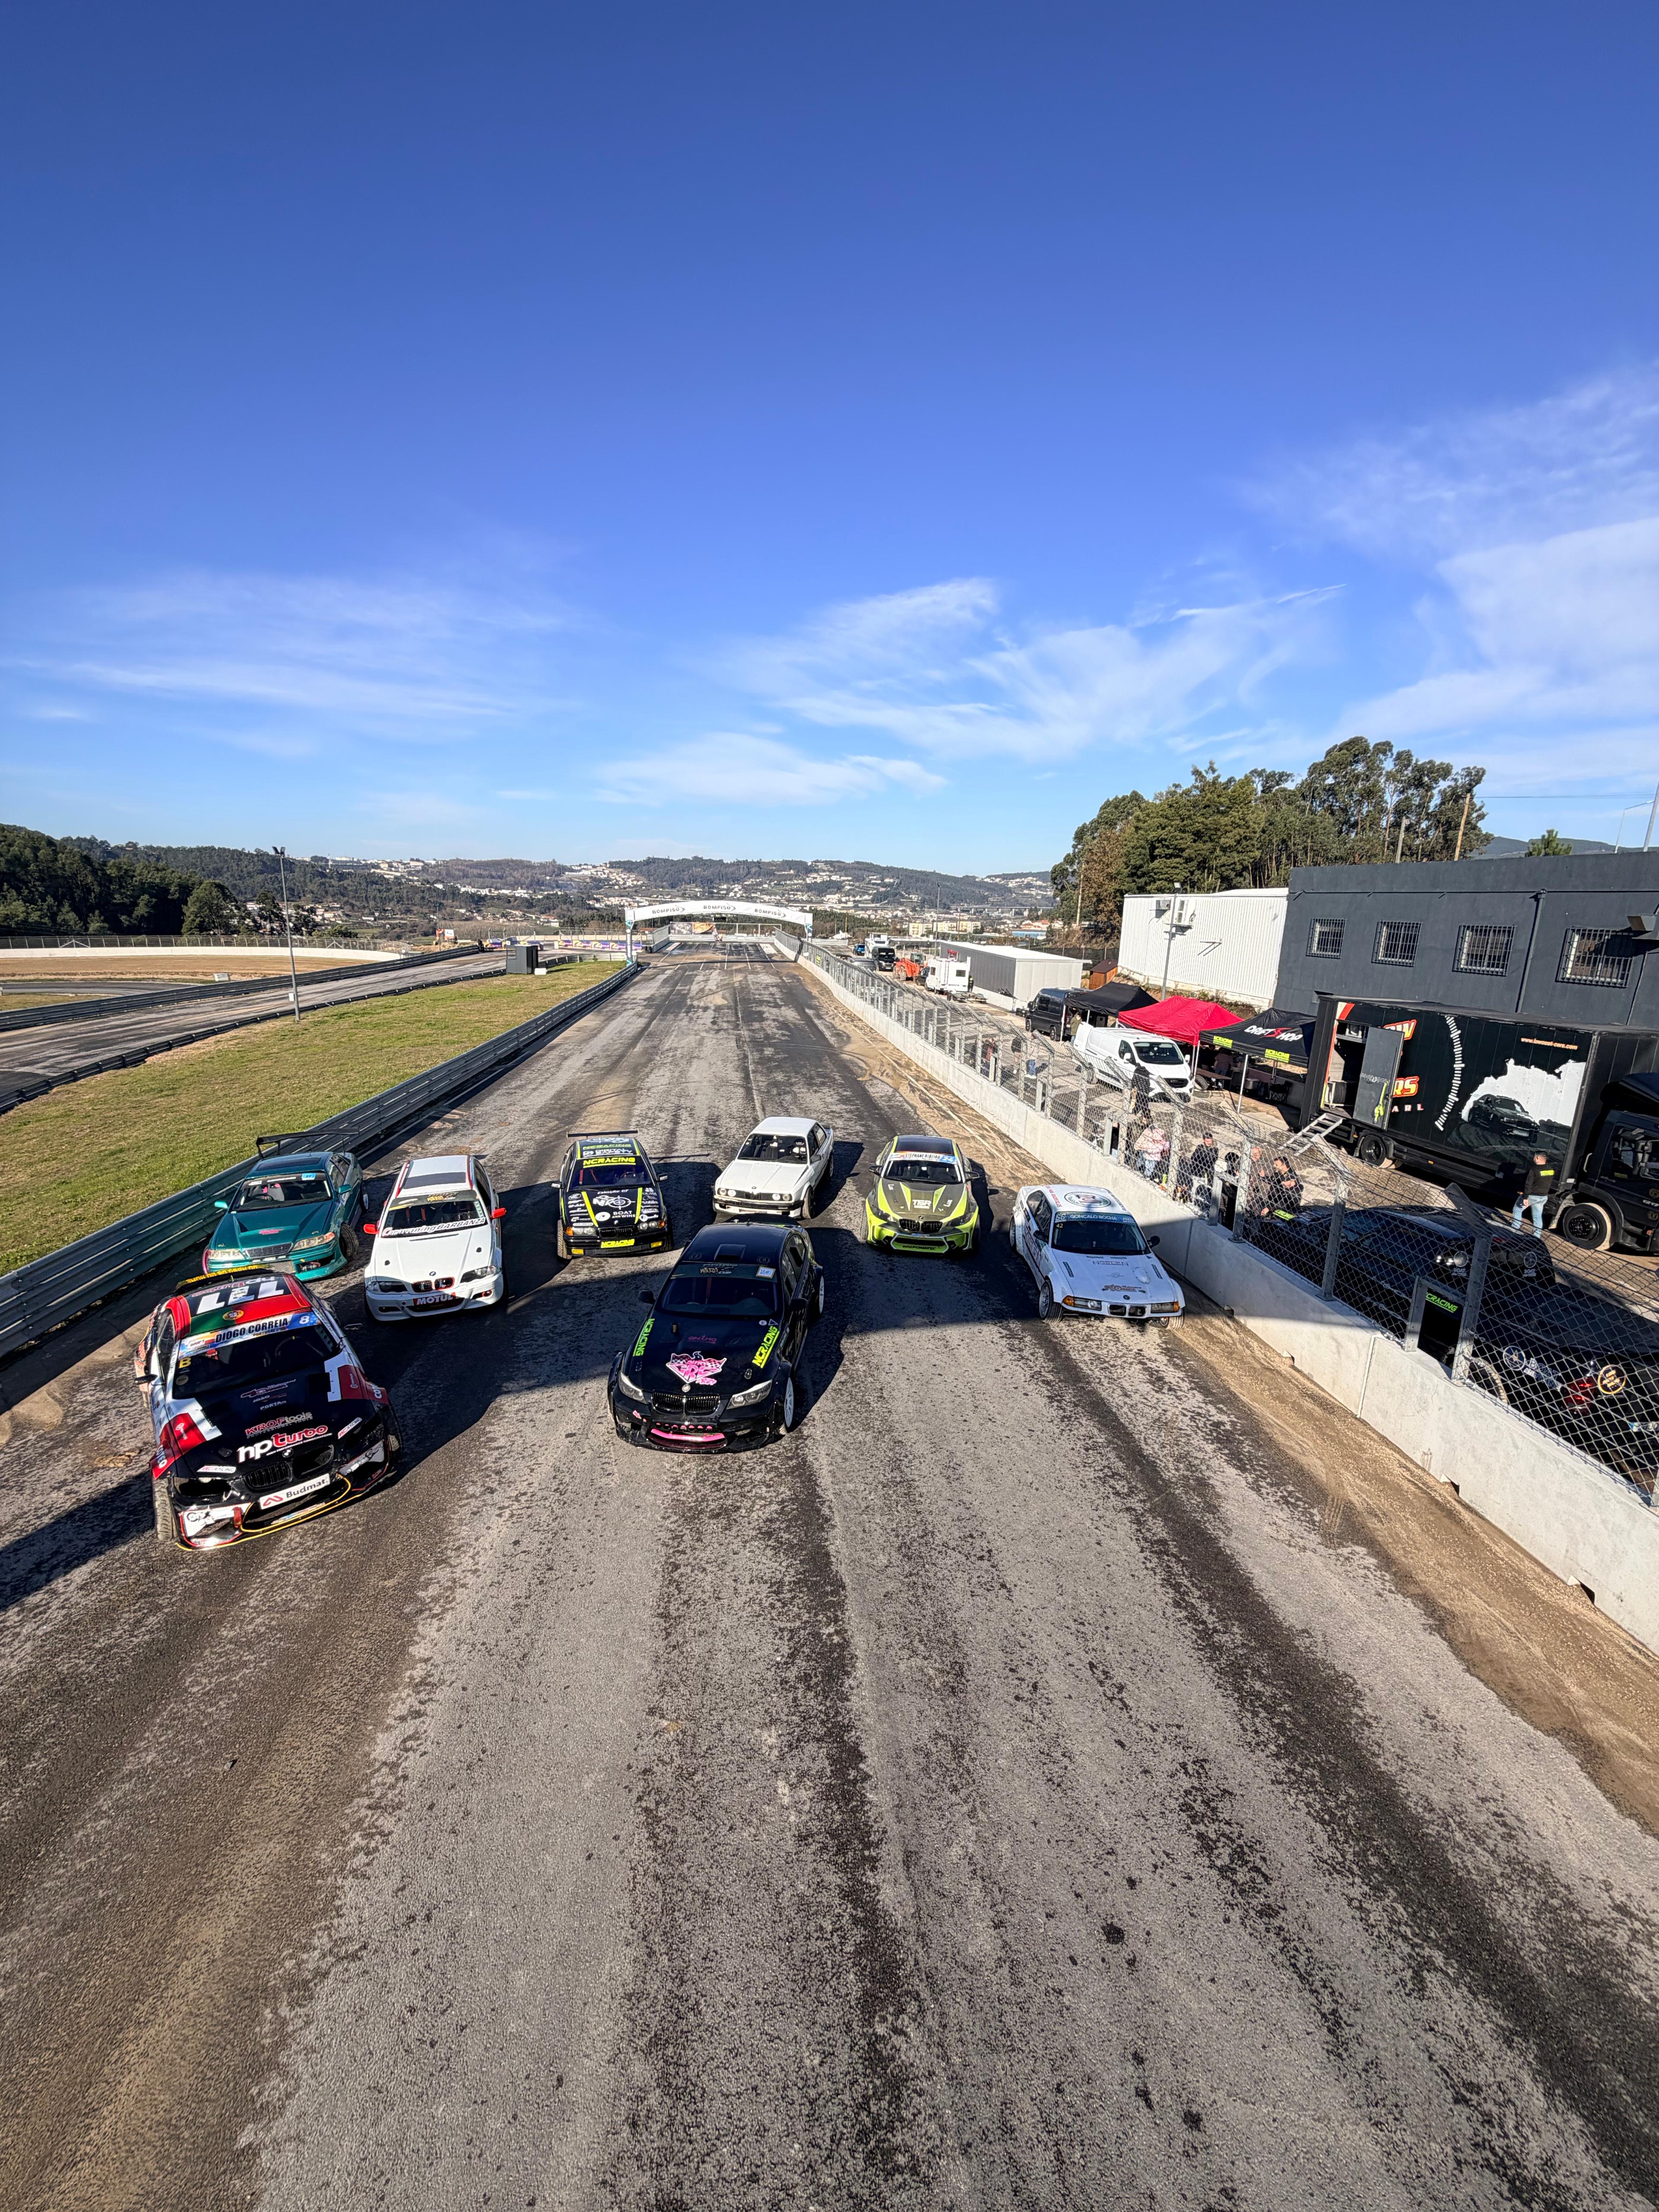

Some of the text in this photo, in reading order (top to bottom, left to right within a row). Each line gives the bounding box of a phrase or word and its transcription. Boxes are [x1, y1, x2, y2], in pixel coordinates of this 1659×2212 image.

[416, 1294, 453, 1306] MOTUL
[1425, 1292, 1458, 1312] CRACING
[216, 1326, 246, 1343] DIOGO
[248, 1318, 288, 1335] CORREIA
[298, 1315, 310, 1325] 8
[635, 1318, 655, 1357] NCRACING
[752, 1325, 778, 1367] NCRACING
[178, 1357, 191, 1369] B
[245, 1412, 312, 1436] KROFtools
